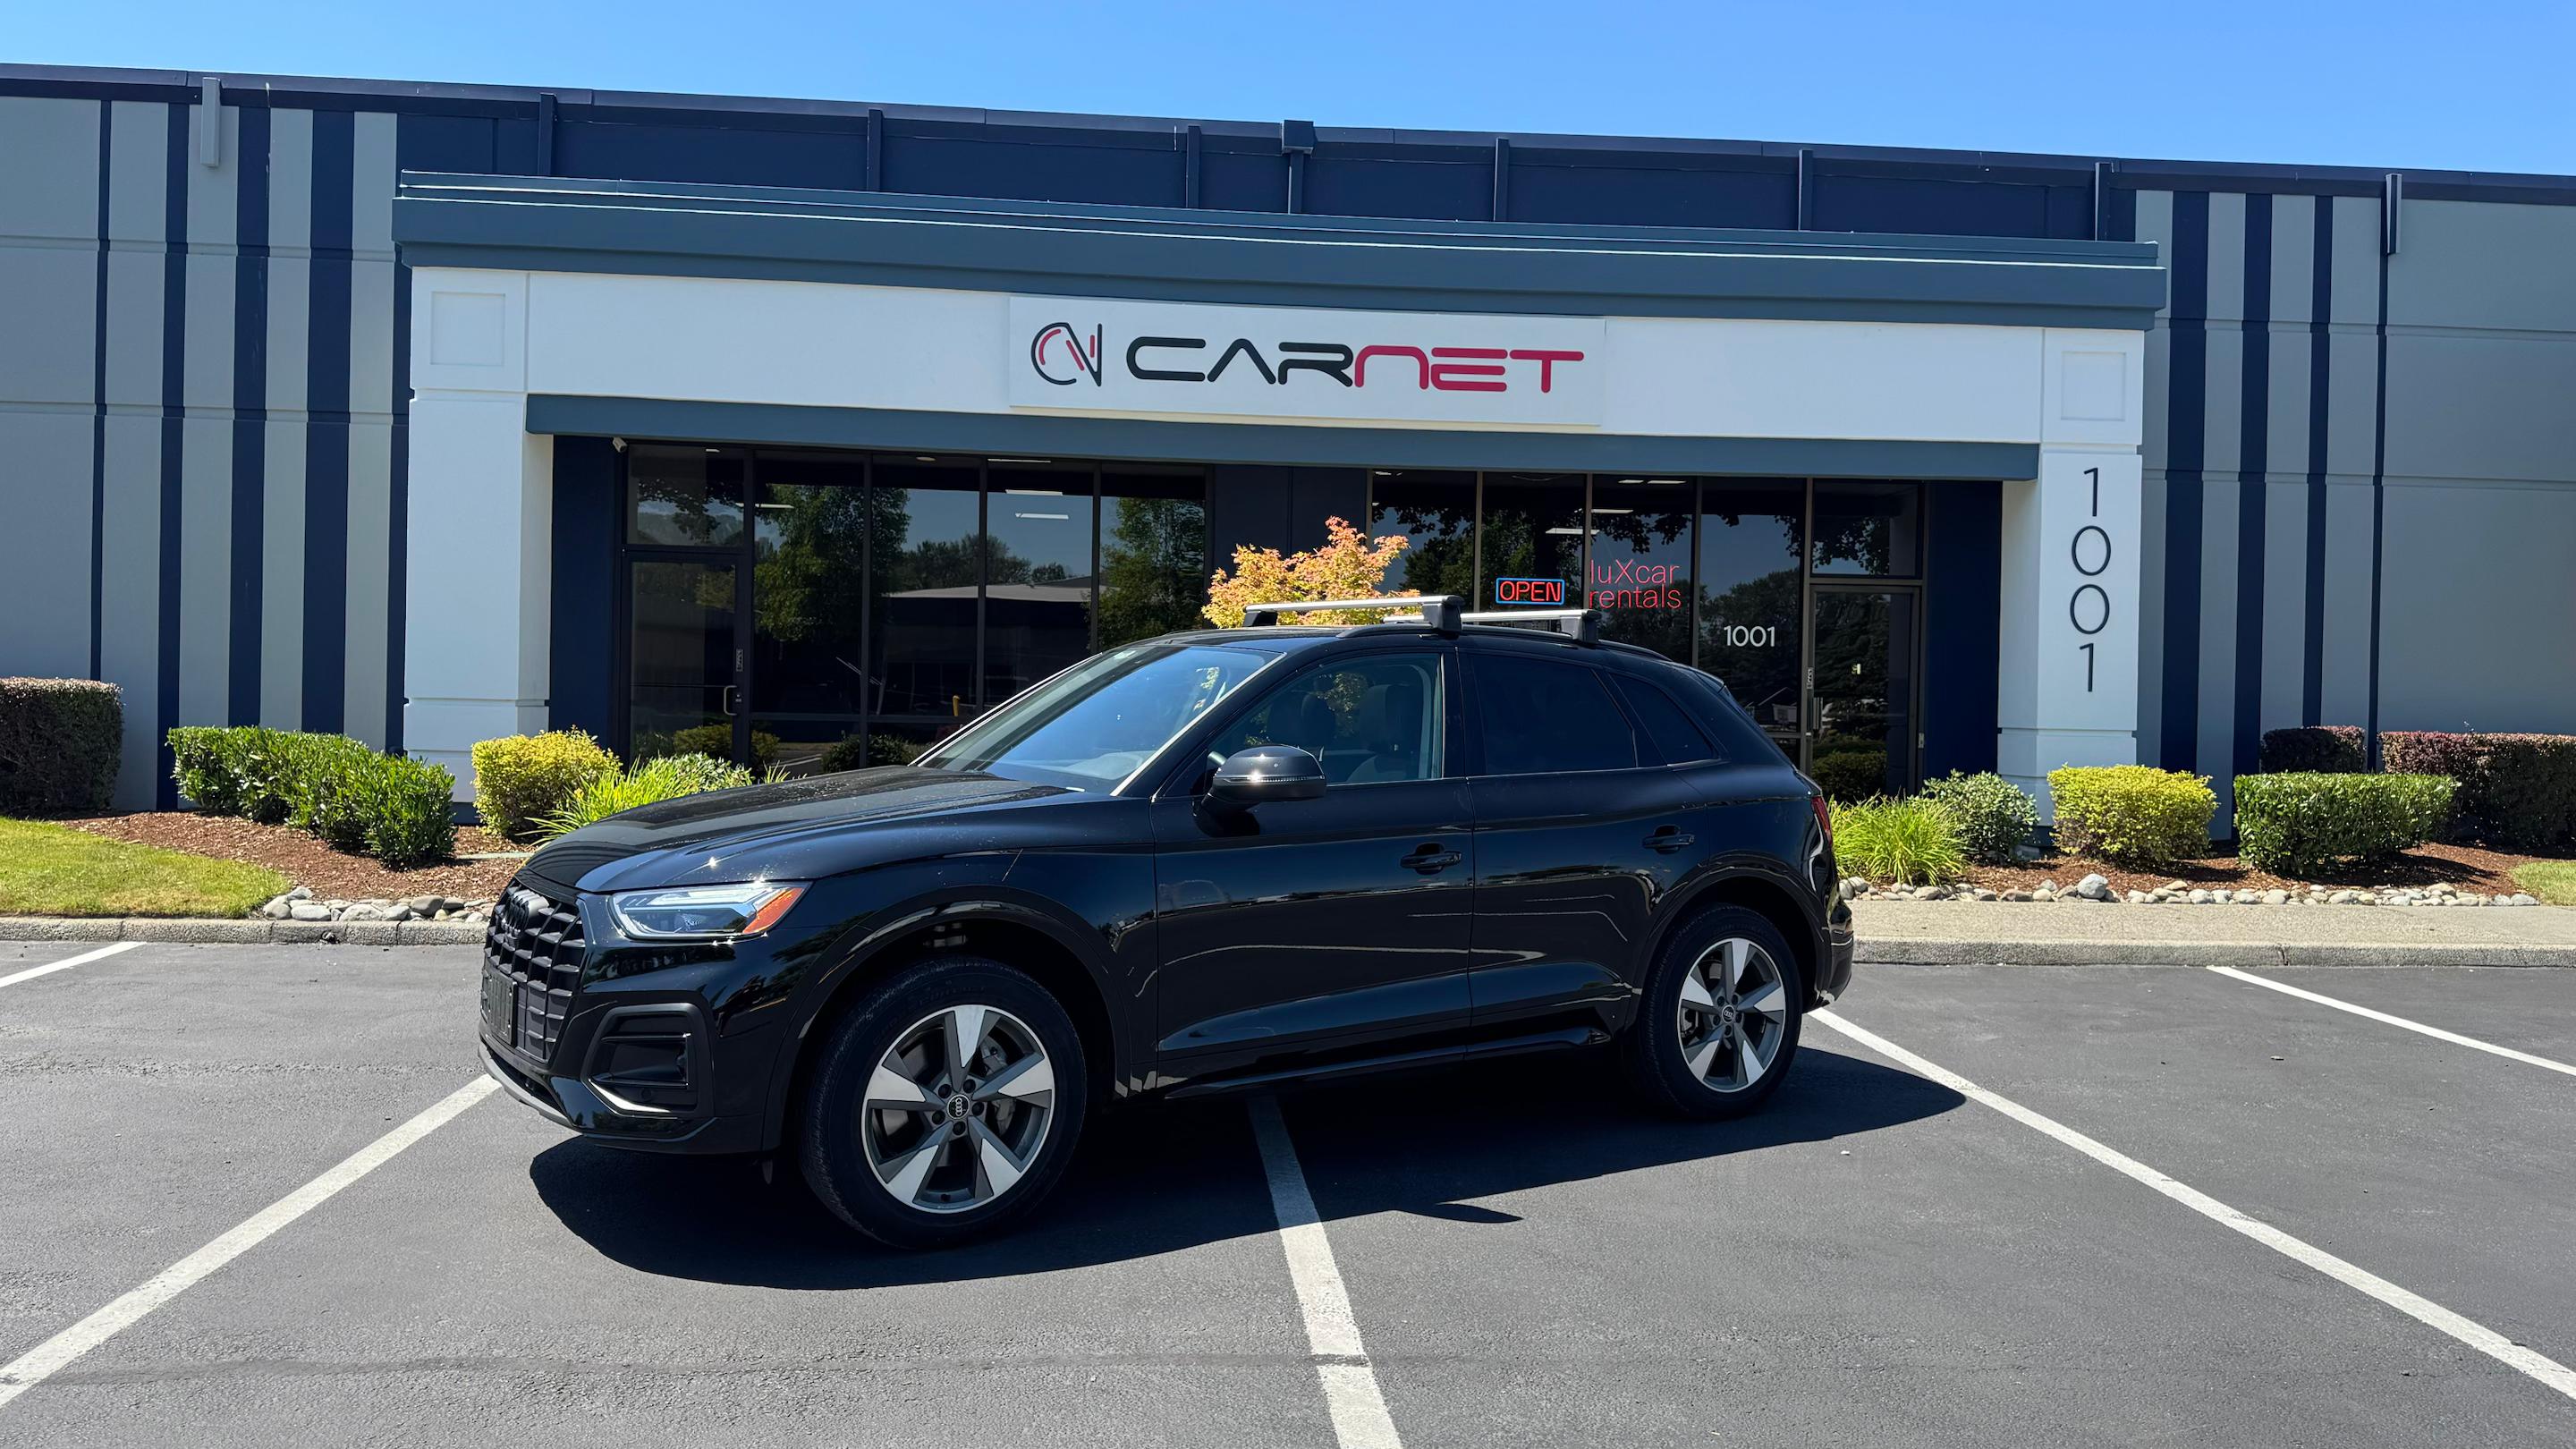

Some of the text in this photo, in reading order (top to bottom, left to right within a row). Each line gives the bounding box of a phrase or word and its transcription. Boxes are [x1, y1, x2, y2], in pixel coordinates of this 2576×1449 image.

[1126, 335, 1584, 393] CARNET
[1589, 559, 1680, 584] luXcar
[2069, 467, 2112, 692] 1001
[1499, 580, 1562, 602] OPEN
[1589, 586, 1682, 609] rentals
[1723, 625, 1776, 647] 1001
